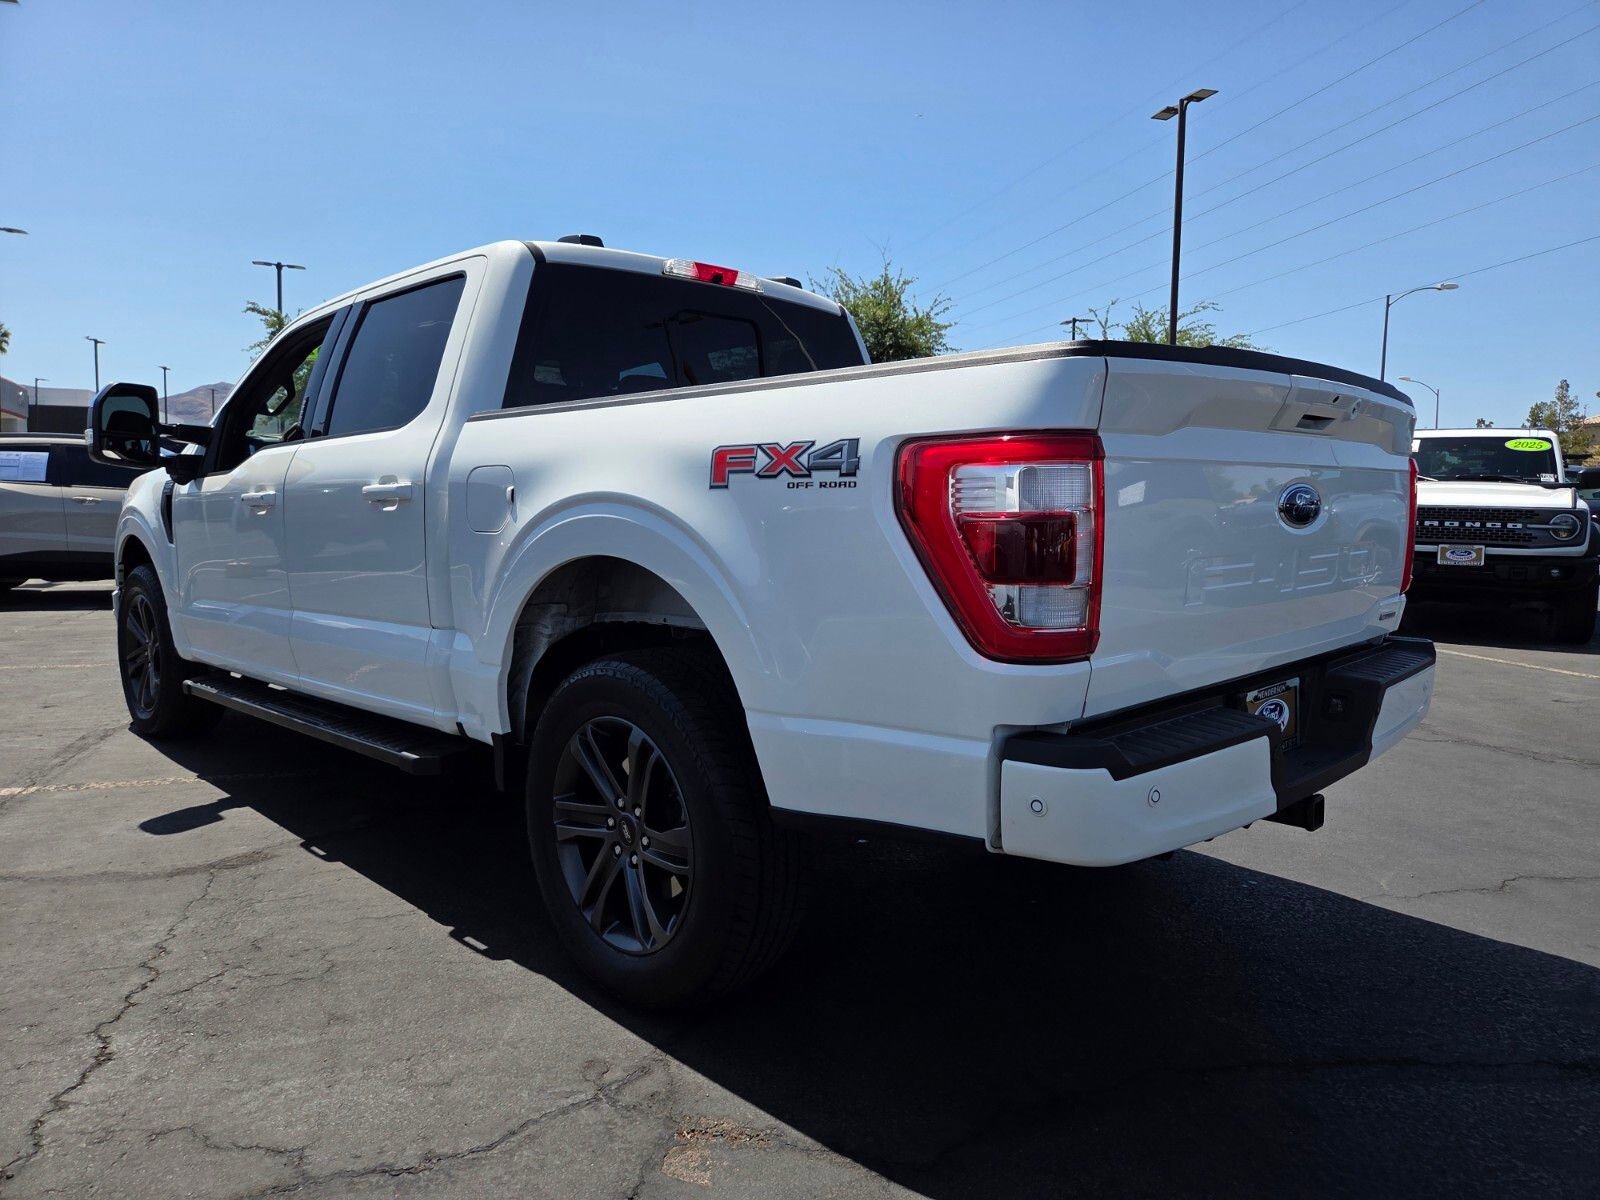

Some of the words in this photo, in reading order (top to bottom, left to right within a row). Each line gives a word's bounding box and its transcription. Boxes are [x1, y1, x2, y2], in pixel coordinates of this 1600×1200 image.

[1514, 441, 1543, 449] 2025
[709, 438, 861, 489] FX4
[787, 481, 814, 489] OFF
[819, 480, 857, 488] ROAD
[1416, 520, 1523, 528] RONCO
[1257, 684, 1286, 699] HENDERSON
